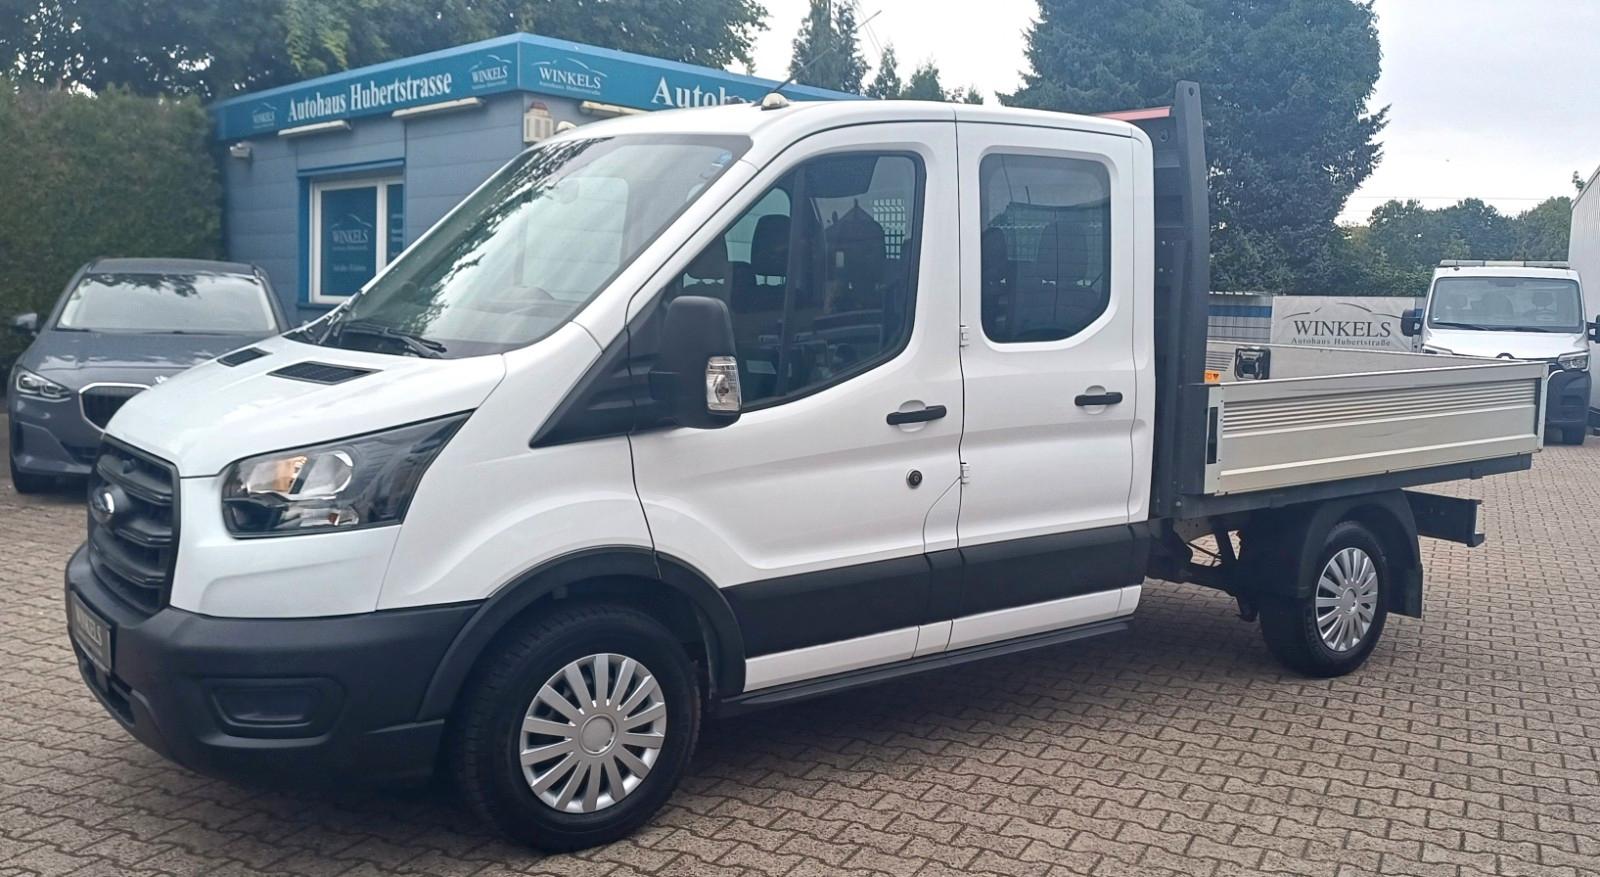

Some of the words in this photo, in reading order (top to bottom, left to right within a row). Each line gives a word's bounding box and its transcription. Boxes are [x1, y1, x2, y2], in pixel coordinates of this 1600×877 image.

[471, 65, 508, 83] WINKELS
[538, 66, 601, 89] WINKELS
[287, 92, 347, 122] Autohaus
[350, 71, 452, 111] Hubertstrasse
[1293, 320, 1392, 338] WINKELS
[1290, 337, 1331, 346] Autohaus
